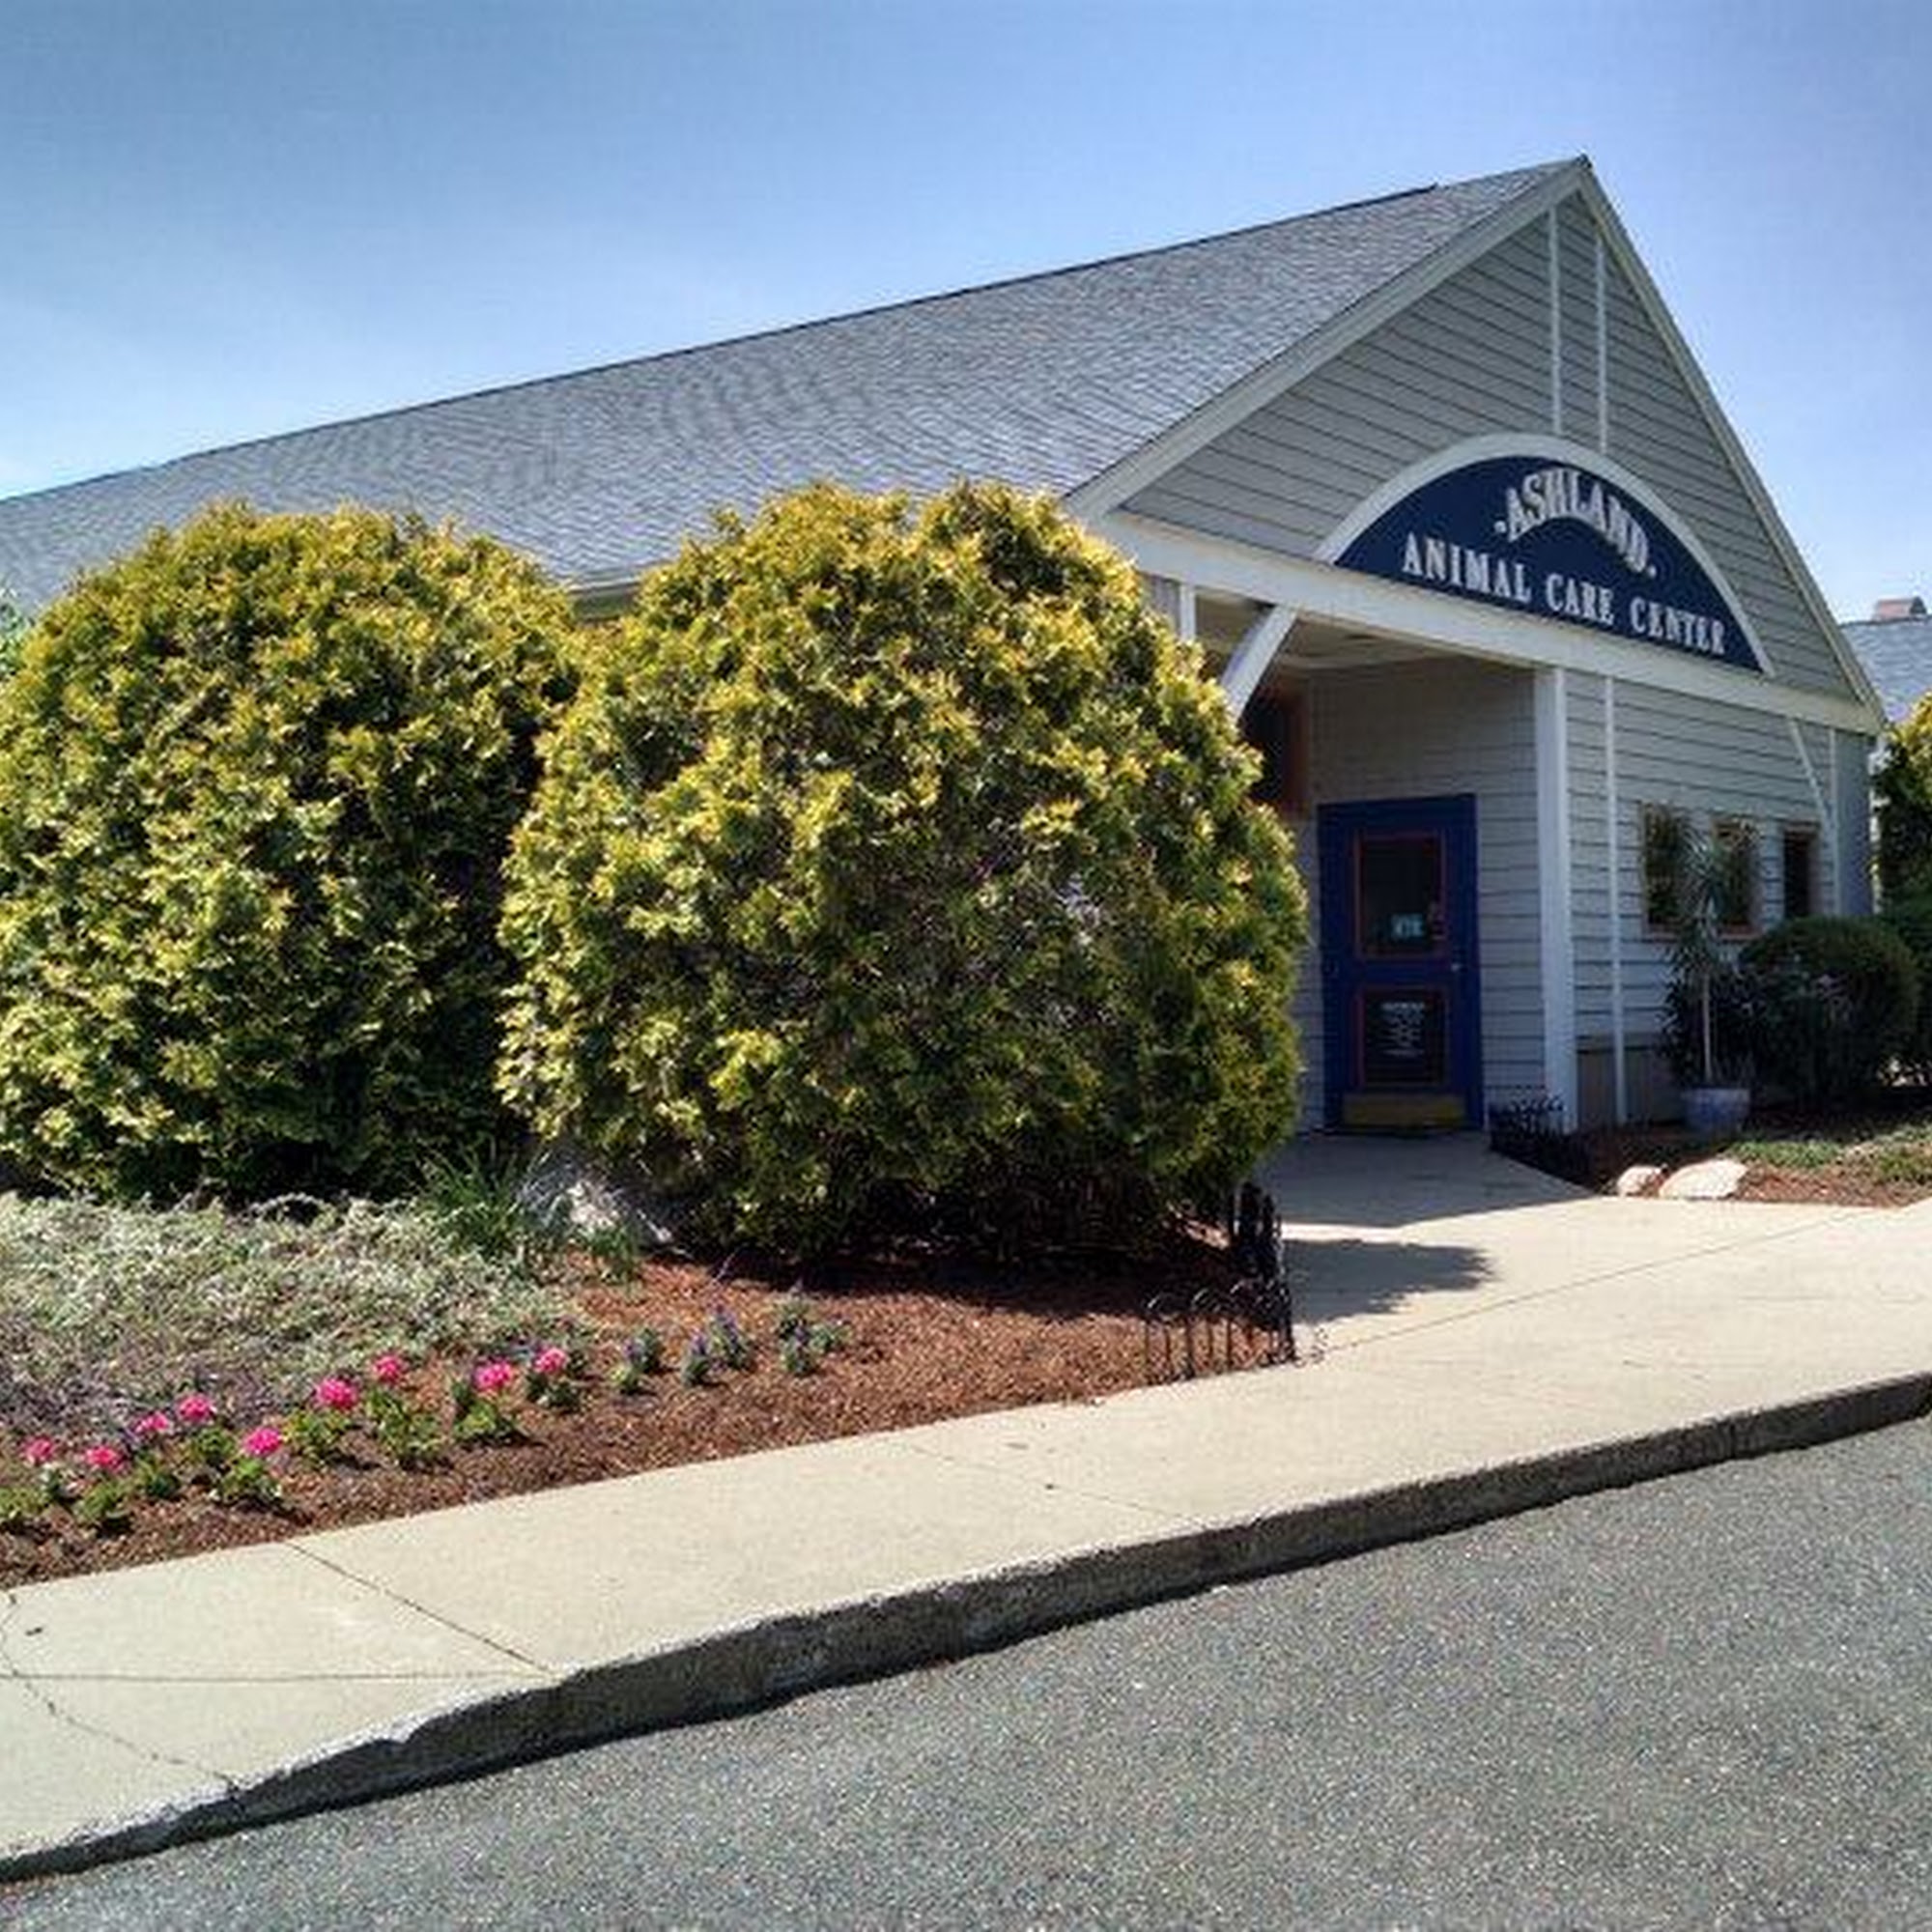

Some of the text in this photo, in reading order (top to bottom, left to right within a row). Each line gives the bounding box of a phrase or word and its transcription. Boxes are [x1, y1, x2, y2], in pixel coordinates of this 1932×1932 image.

[1403, 532, 1725, 655] ANIMAL CARE CENTER
